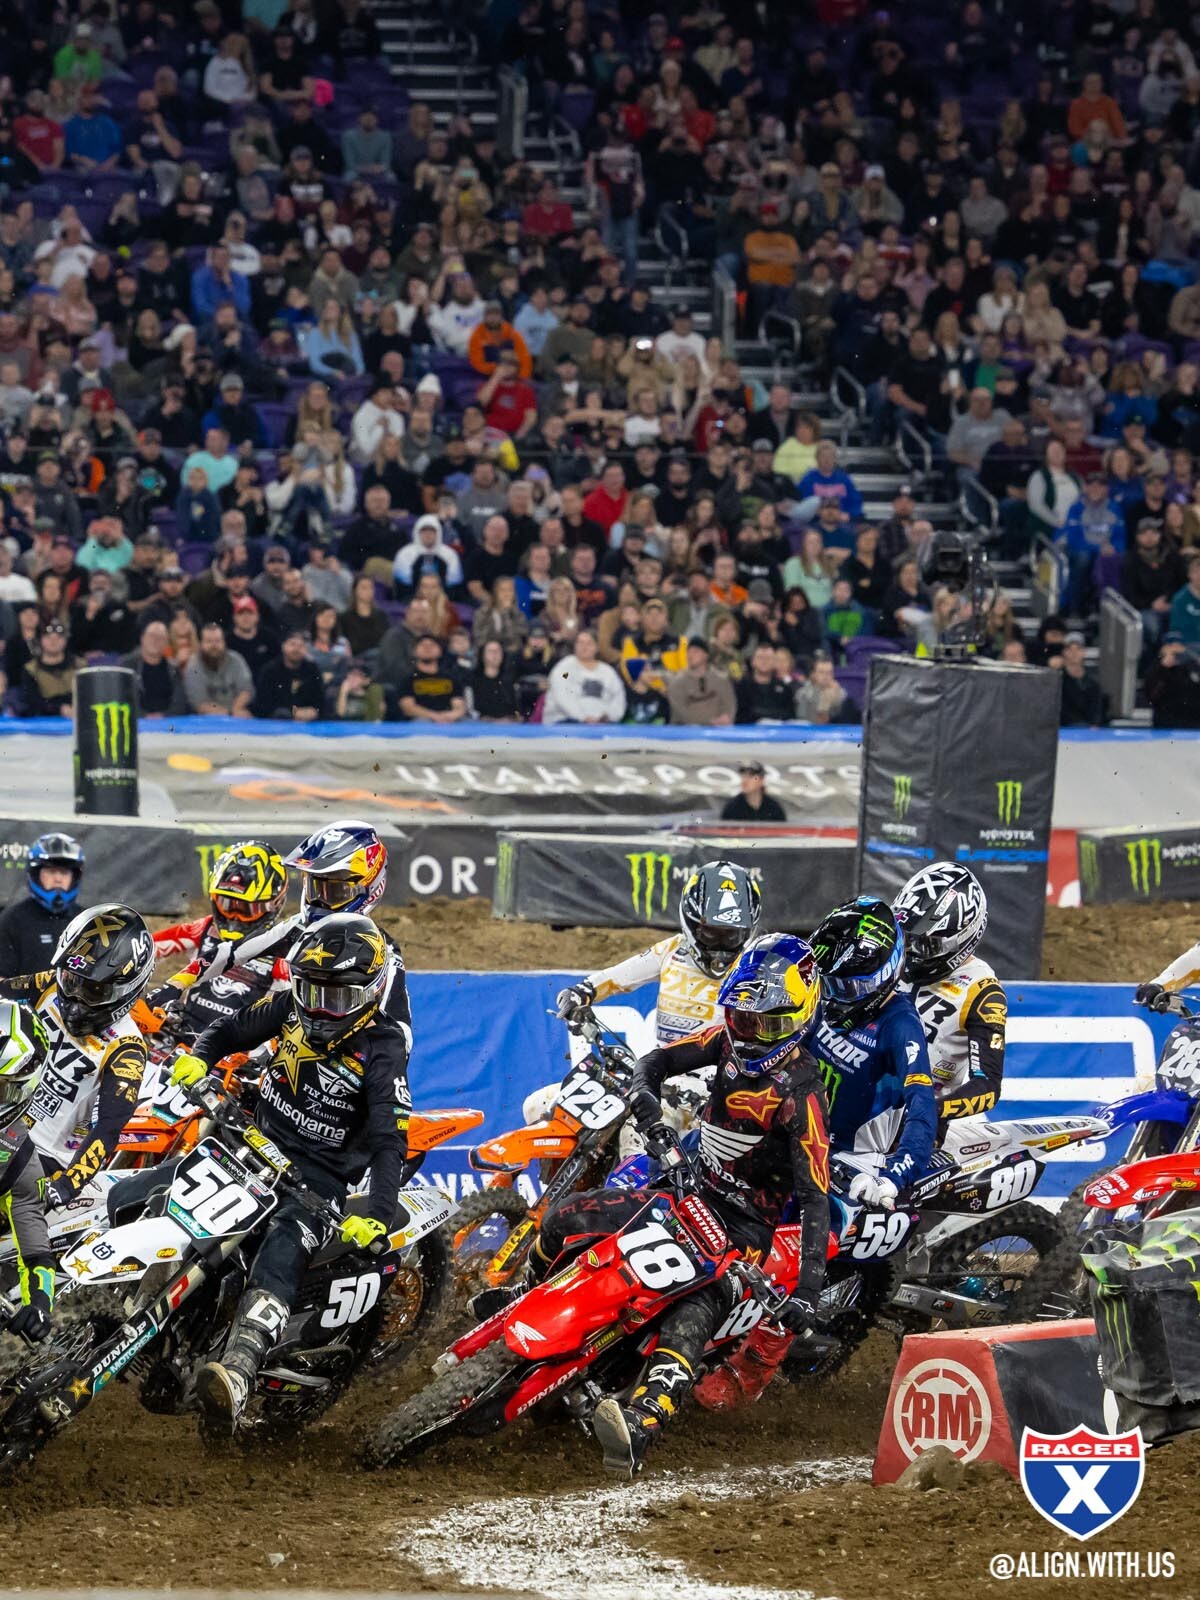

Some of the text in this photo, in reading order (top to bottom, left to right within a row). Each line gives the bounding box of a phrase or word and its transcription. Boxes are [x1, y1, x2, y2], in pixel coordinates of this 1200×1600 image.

[399, 763, 582, 787] UTAH
[816, 1023, 870, 1068] THOR
[267, 1085, 346, 1141] Husqvarna
[303, 1083, 318, 1098] FLY
[557, 1073, 627, 1130] 129
[941, 1091, 996, 1119] FXR
[428, 1126, 457, 1143] DUNLOP
[171, 1156, 258, 1236] 50
[919, 1171, 951, 1195] DUNLOP
[986, 1159, 1037, 1209] 80
[421, 1210, 450, 1232] DUNLOP
[685, 1200, 721, 1250] RENTHAL
[853, 1211, 911, 1260] 59
[616, 1221, 696, 1289] 18
[320, 1272, 381, 1328] 50
[713, 1298, 767, 1341] 18
[508, 1324, 530, 1354] HONDA
[516, 1366, 579, 1416] DUNLOP
[912, 1390, 971, 1441] RM
